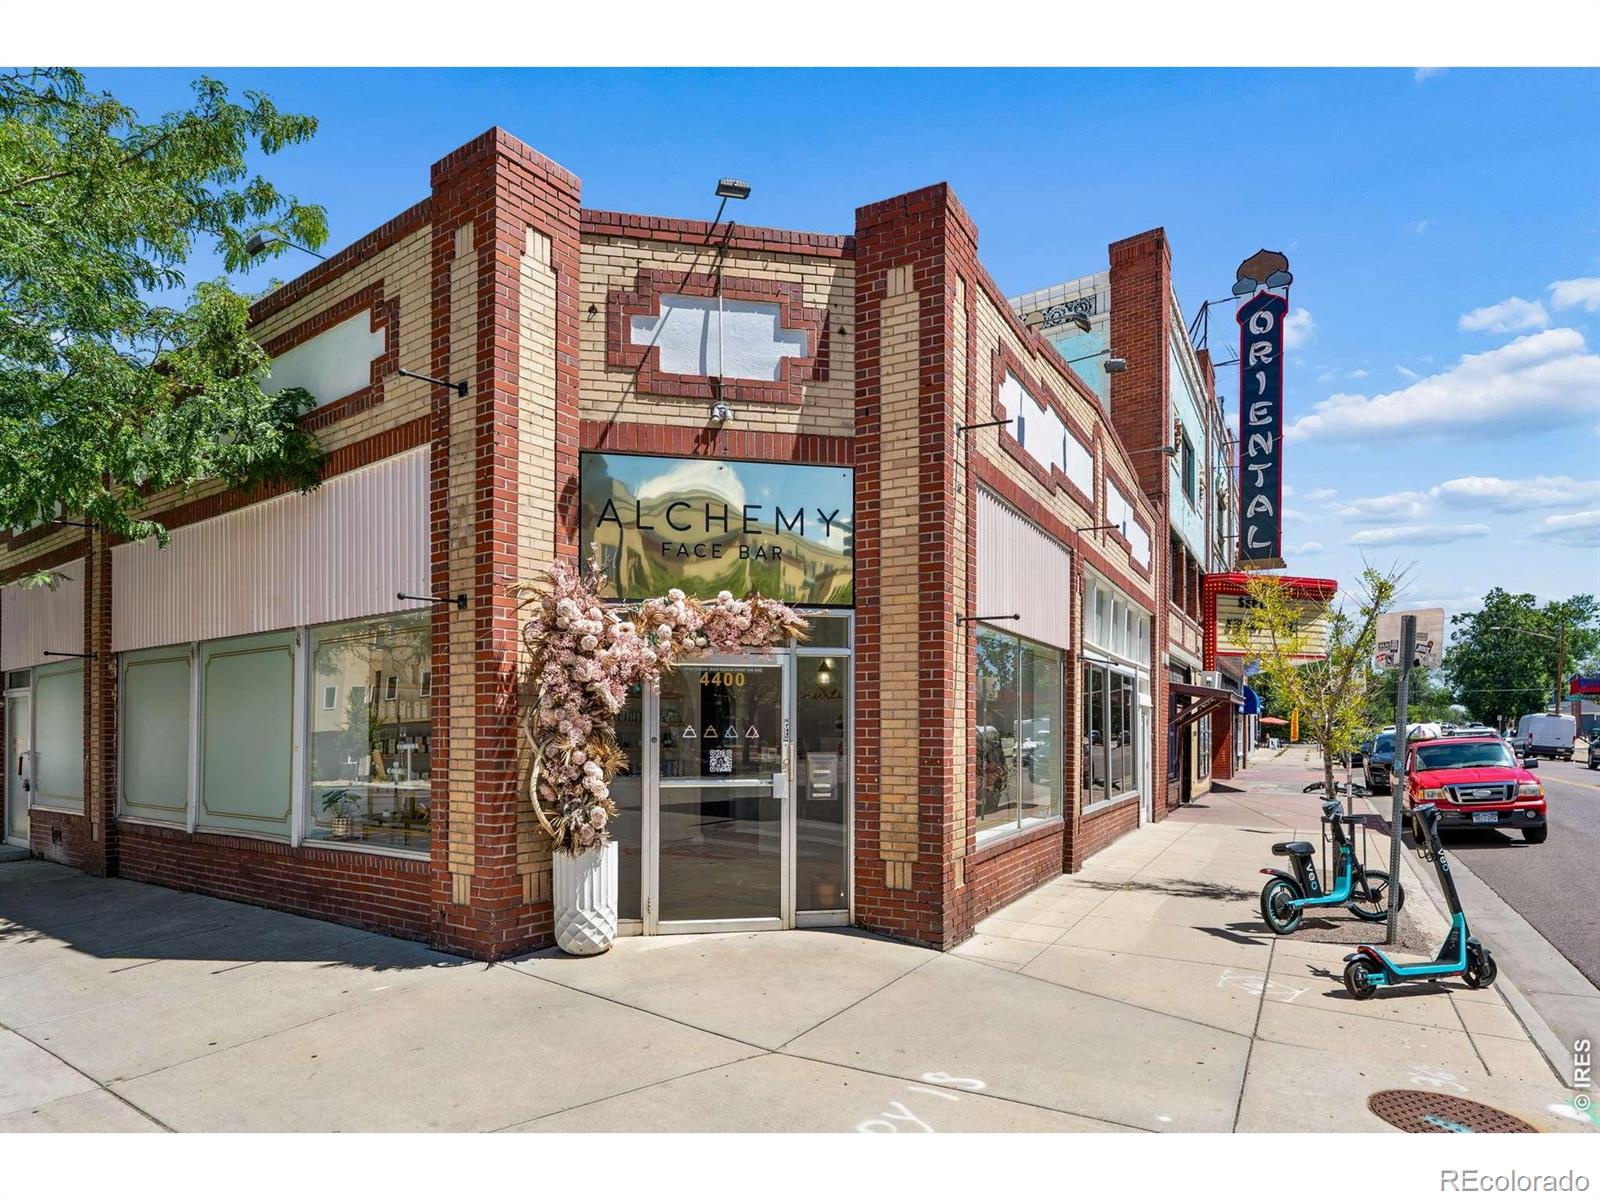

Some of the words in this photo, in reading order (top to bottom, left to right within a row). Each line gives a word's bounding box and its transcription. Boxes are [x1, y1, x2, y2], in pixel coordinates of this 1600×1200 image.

[1246, 310, 1274, 549] ORIENTAL
[596, 498, 840, 537] ALCHEMY
[661, 542, 722, 559] FACE
[738, 545, 783, 561] BAR
[700, 671, 745, 687] 4400
[1306, 864, 1318, 891] veo
